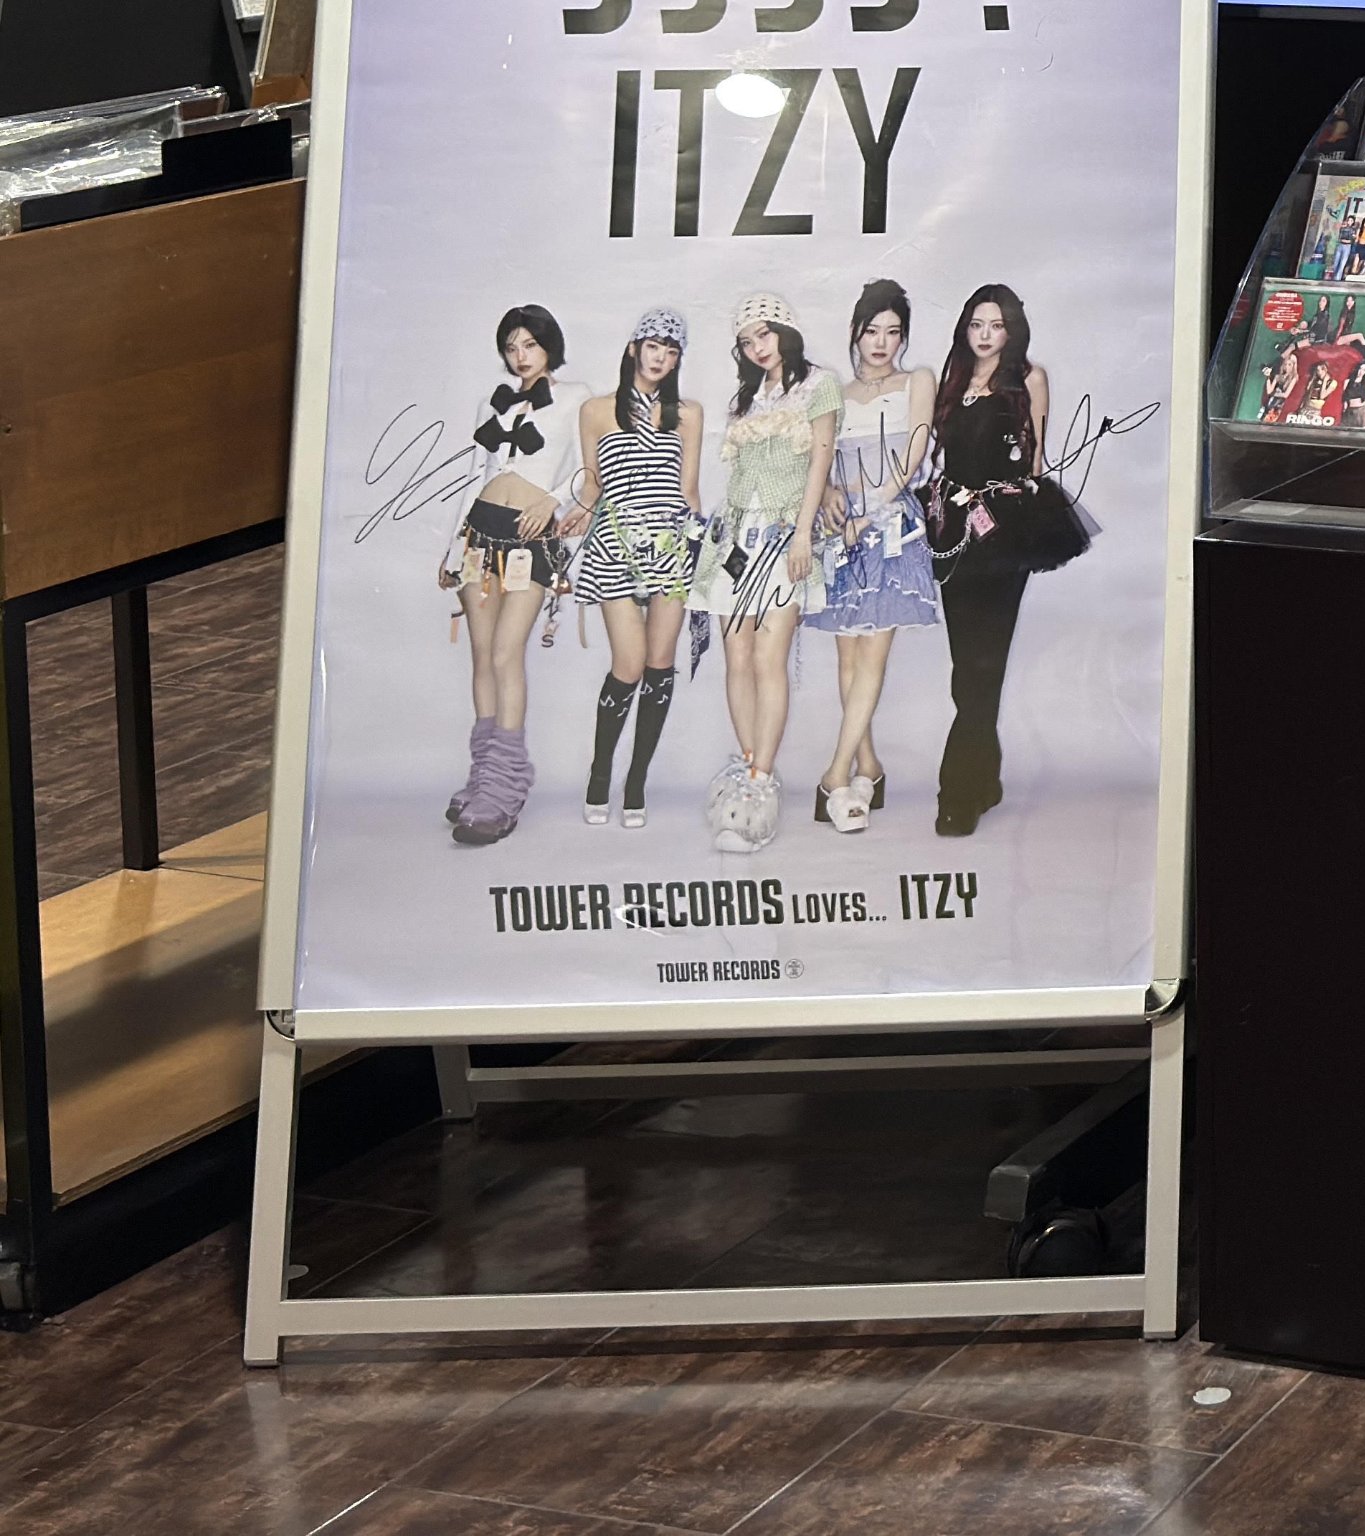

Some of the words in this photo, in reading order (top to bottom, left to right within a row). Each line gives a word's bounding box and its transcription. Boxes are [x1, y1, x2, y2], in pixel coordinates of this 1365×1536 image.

[609, 67, 922, 238] ITZY
[1285, 414, 1335, 427] RINGO
[489, 883, 612, 933] TOWER
[622, 878, 784, 929] RECORDS
[793, 891, 887, 924] LOVES...
[899, 872, 978, 921] ITZY
[657, 962, 709, 983] TOWER
[713, 960, 781, 981] RECORDS
